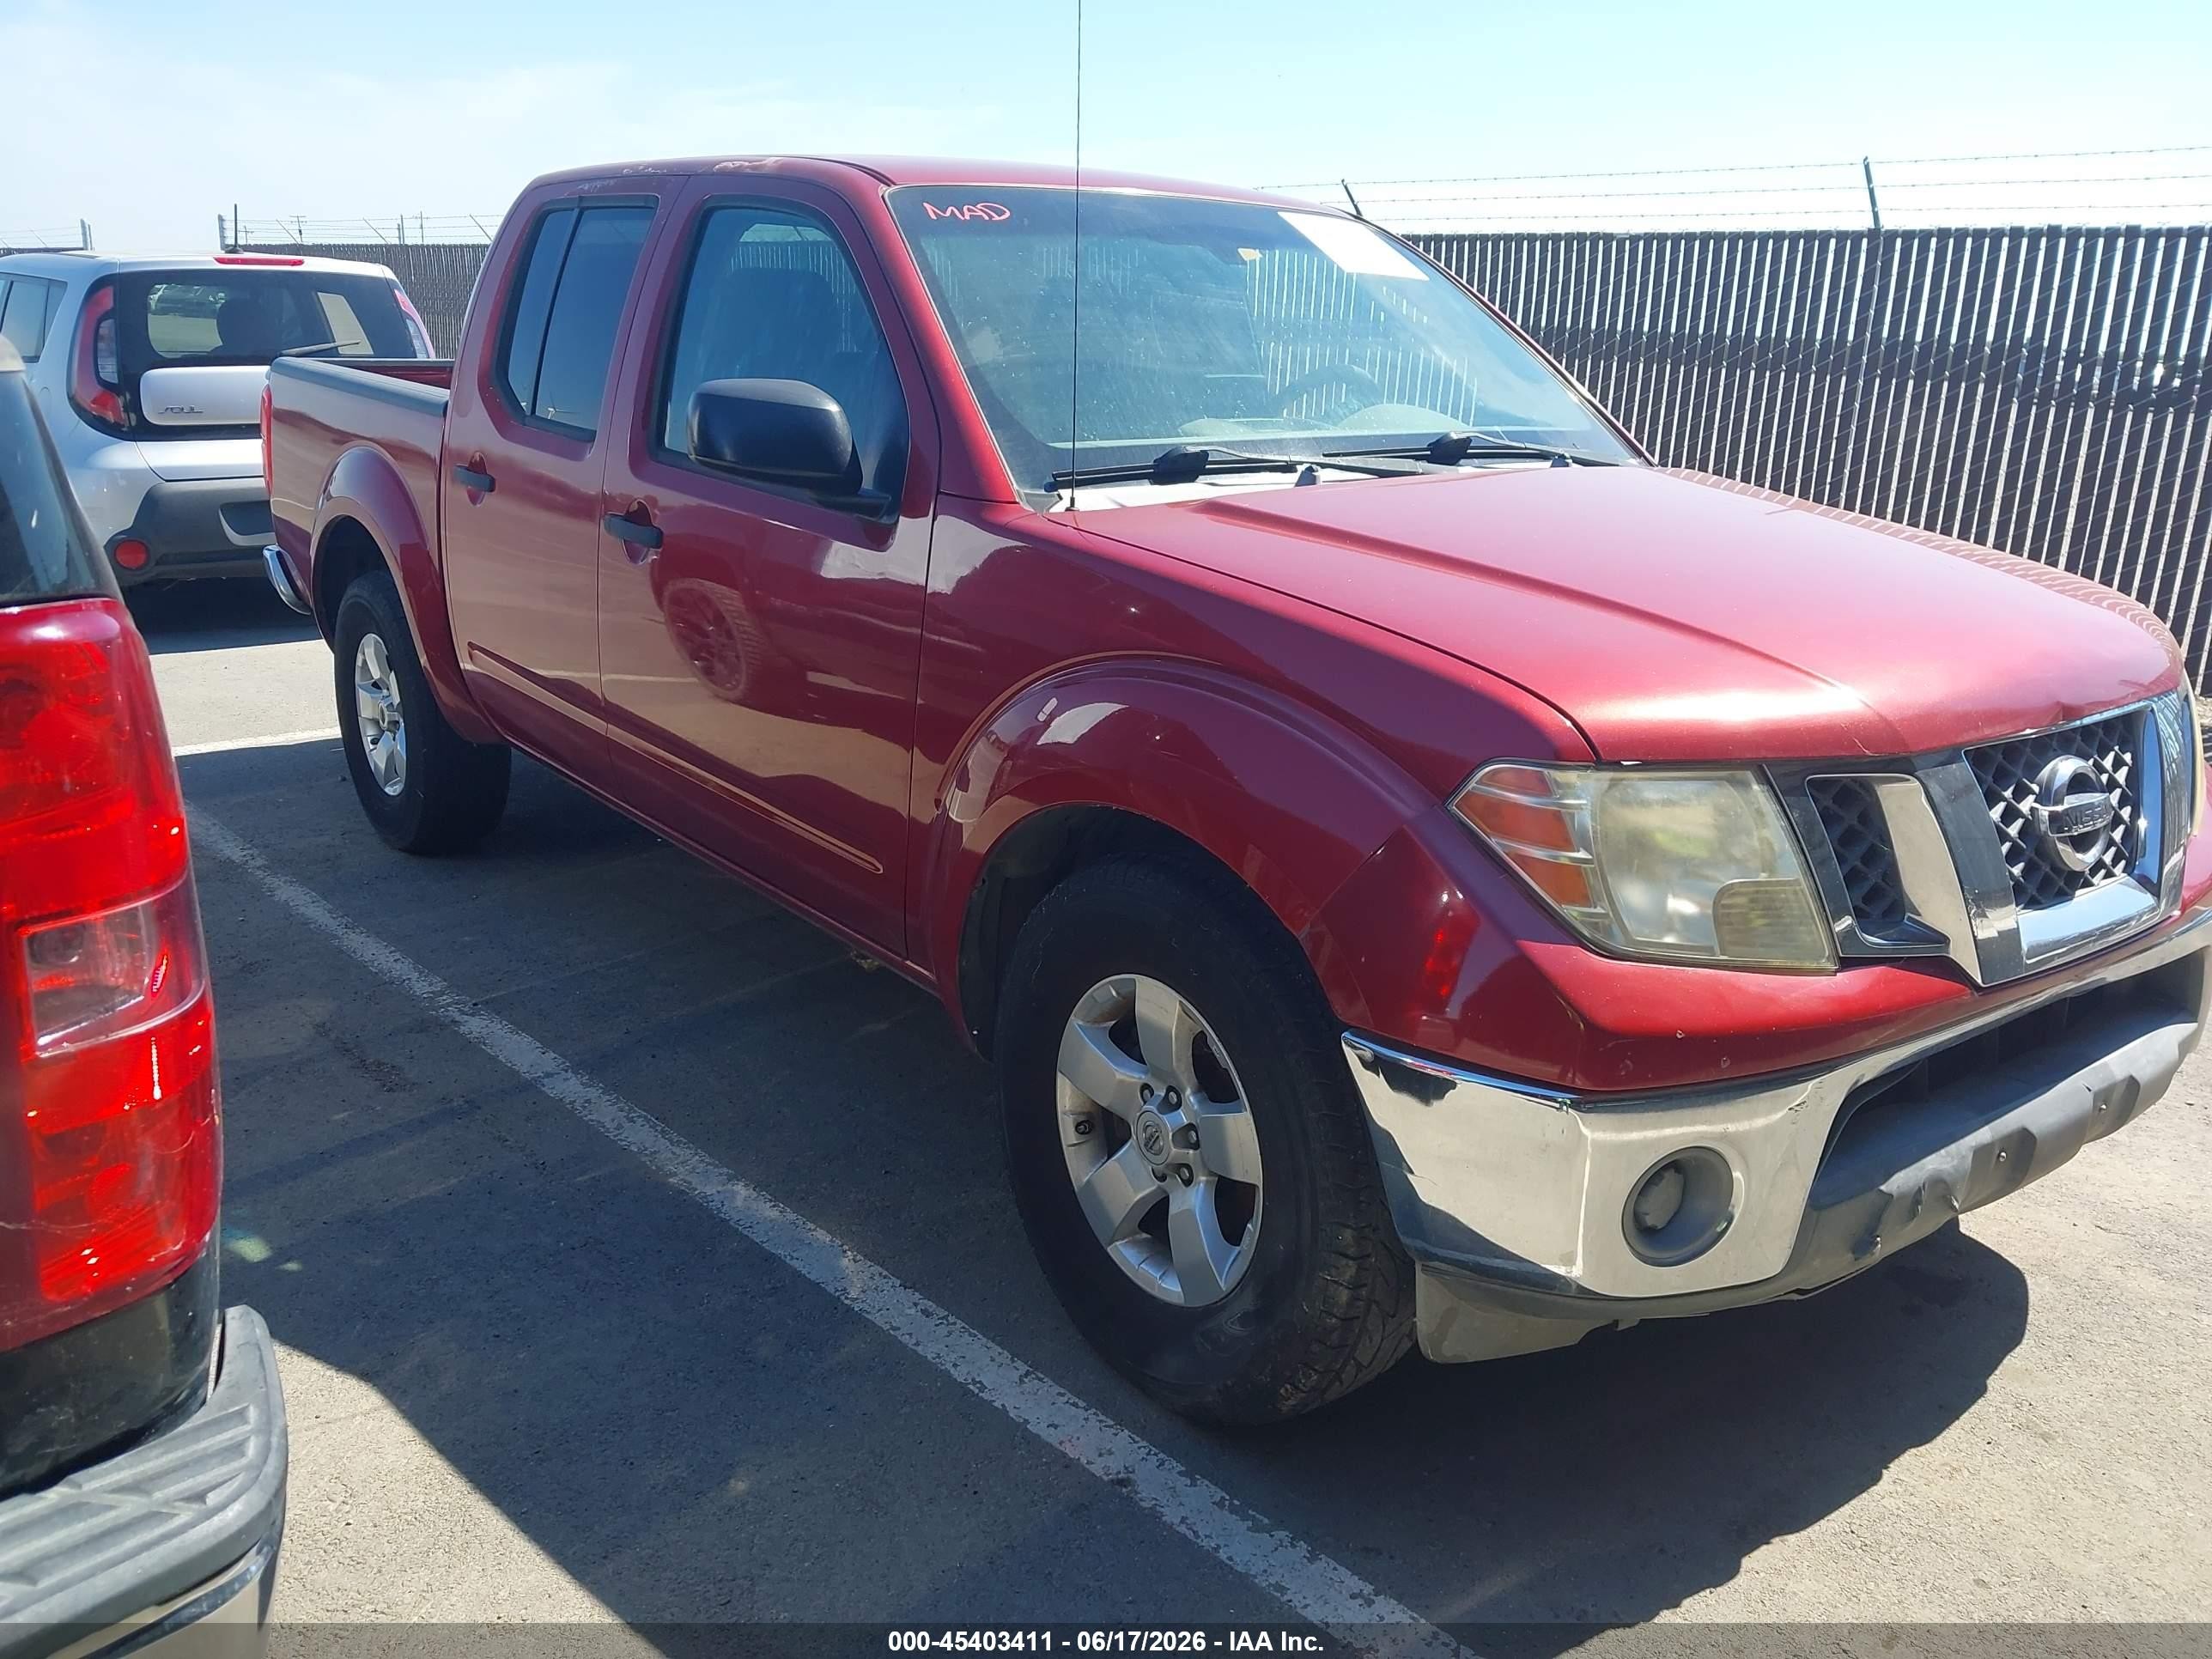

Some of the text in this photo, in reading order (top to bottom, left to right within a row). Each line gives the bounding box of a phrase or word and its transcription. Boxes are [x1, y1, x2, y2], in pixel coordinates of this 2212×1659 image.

[921, 201, 1012, 221] MAD
[158, 404, 204, 415] SOUL
[2063, 805, 2110, 831] NISS
